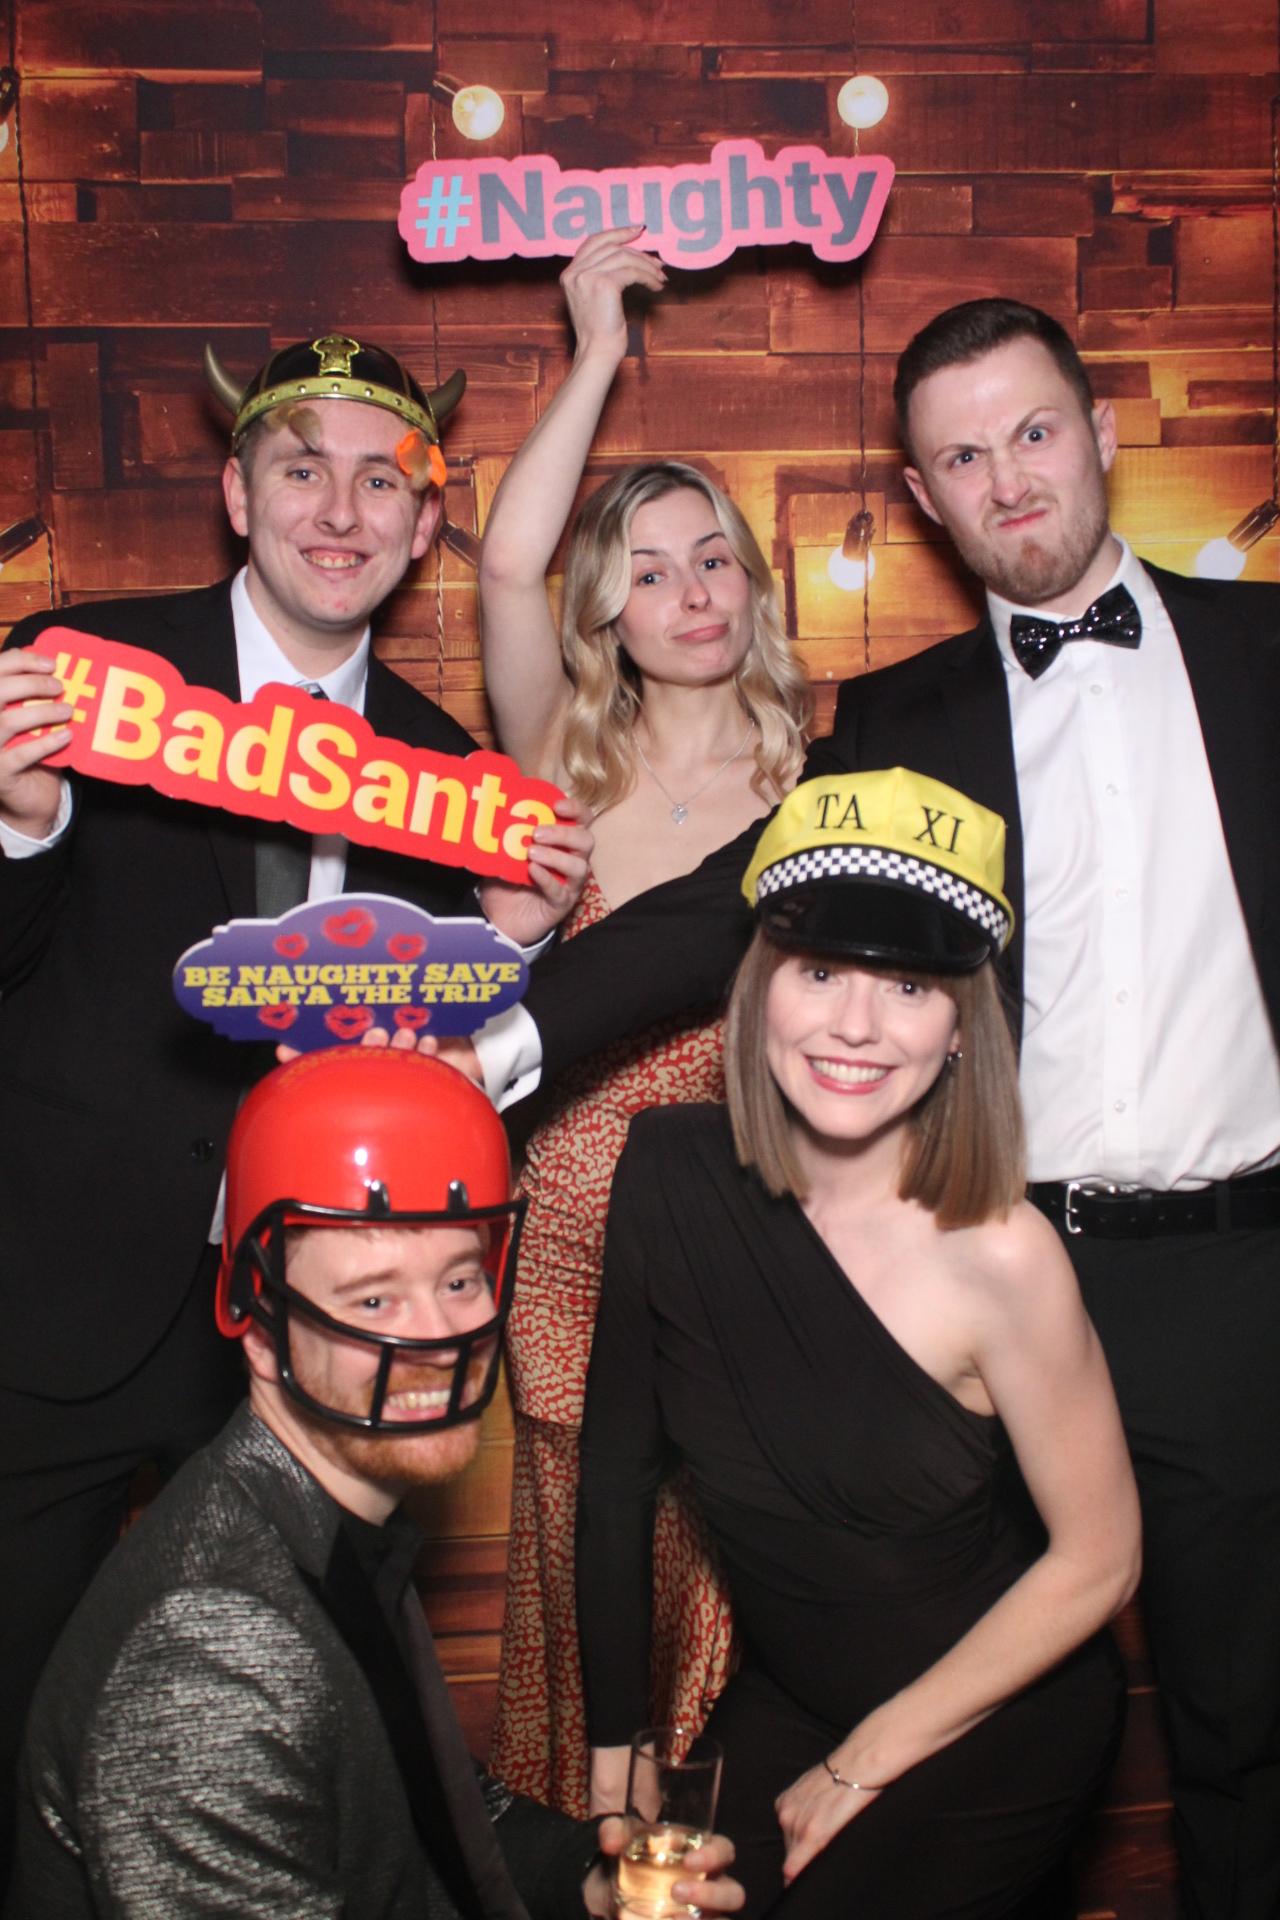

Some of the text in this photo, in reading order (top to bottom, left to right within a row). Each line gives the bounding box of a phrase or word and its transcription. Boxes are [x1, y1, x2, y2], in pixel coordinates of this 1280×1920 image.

[414, 154, 877, 253] #Naughty
[21, 651, 557, 861] #BadSanta
[183, 962, 521, 987] BE NAUGHTY SAVE
[202, 982, 501, 1006] SANTA THE TRIP
